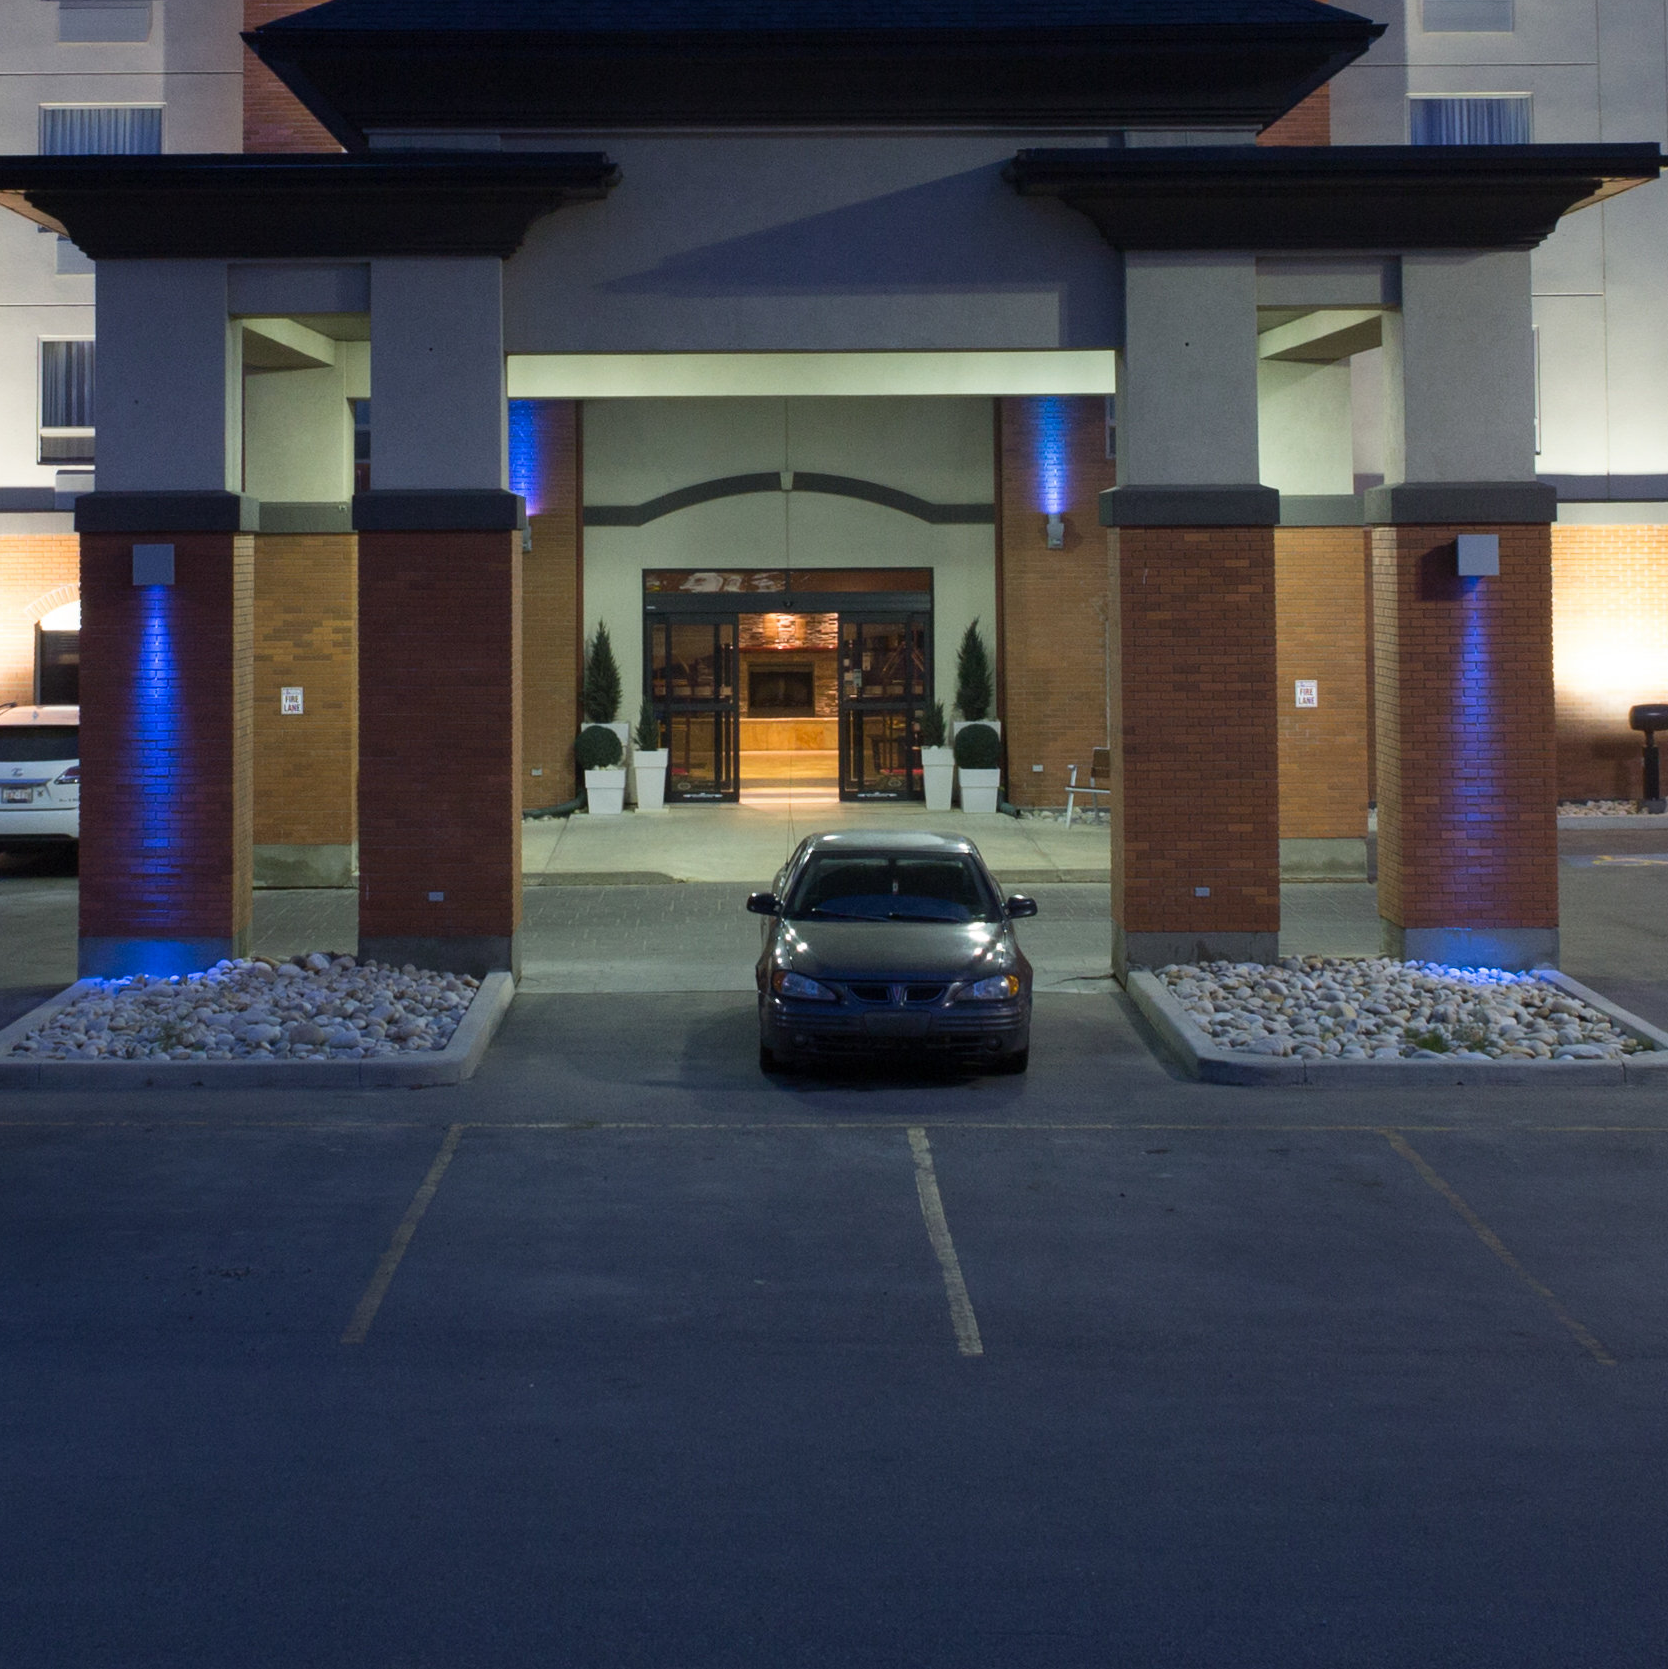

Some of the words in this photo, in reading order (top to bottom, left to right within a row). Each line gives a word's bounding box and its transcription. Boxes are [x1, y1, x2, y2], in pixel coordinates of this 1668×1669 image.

[1299, 688, 1314, 696] FIRE
[285, 695, 299, 703] FIRE
[284, 704, 300, 712] LANE
